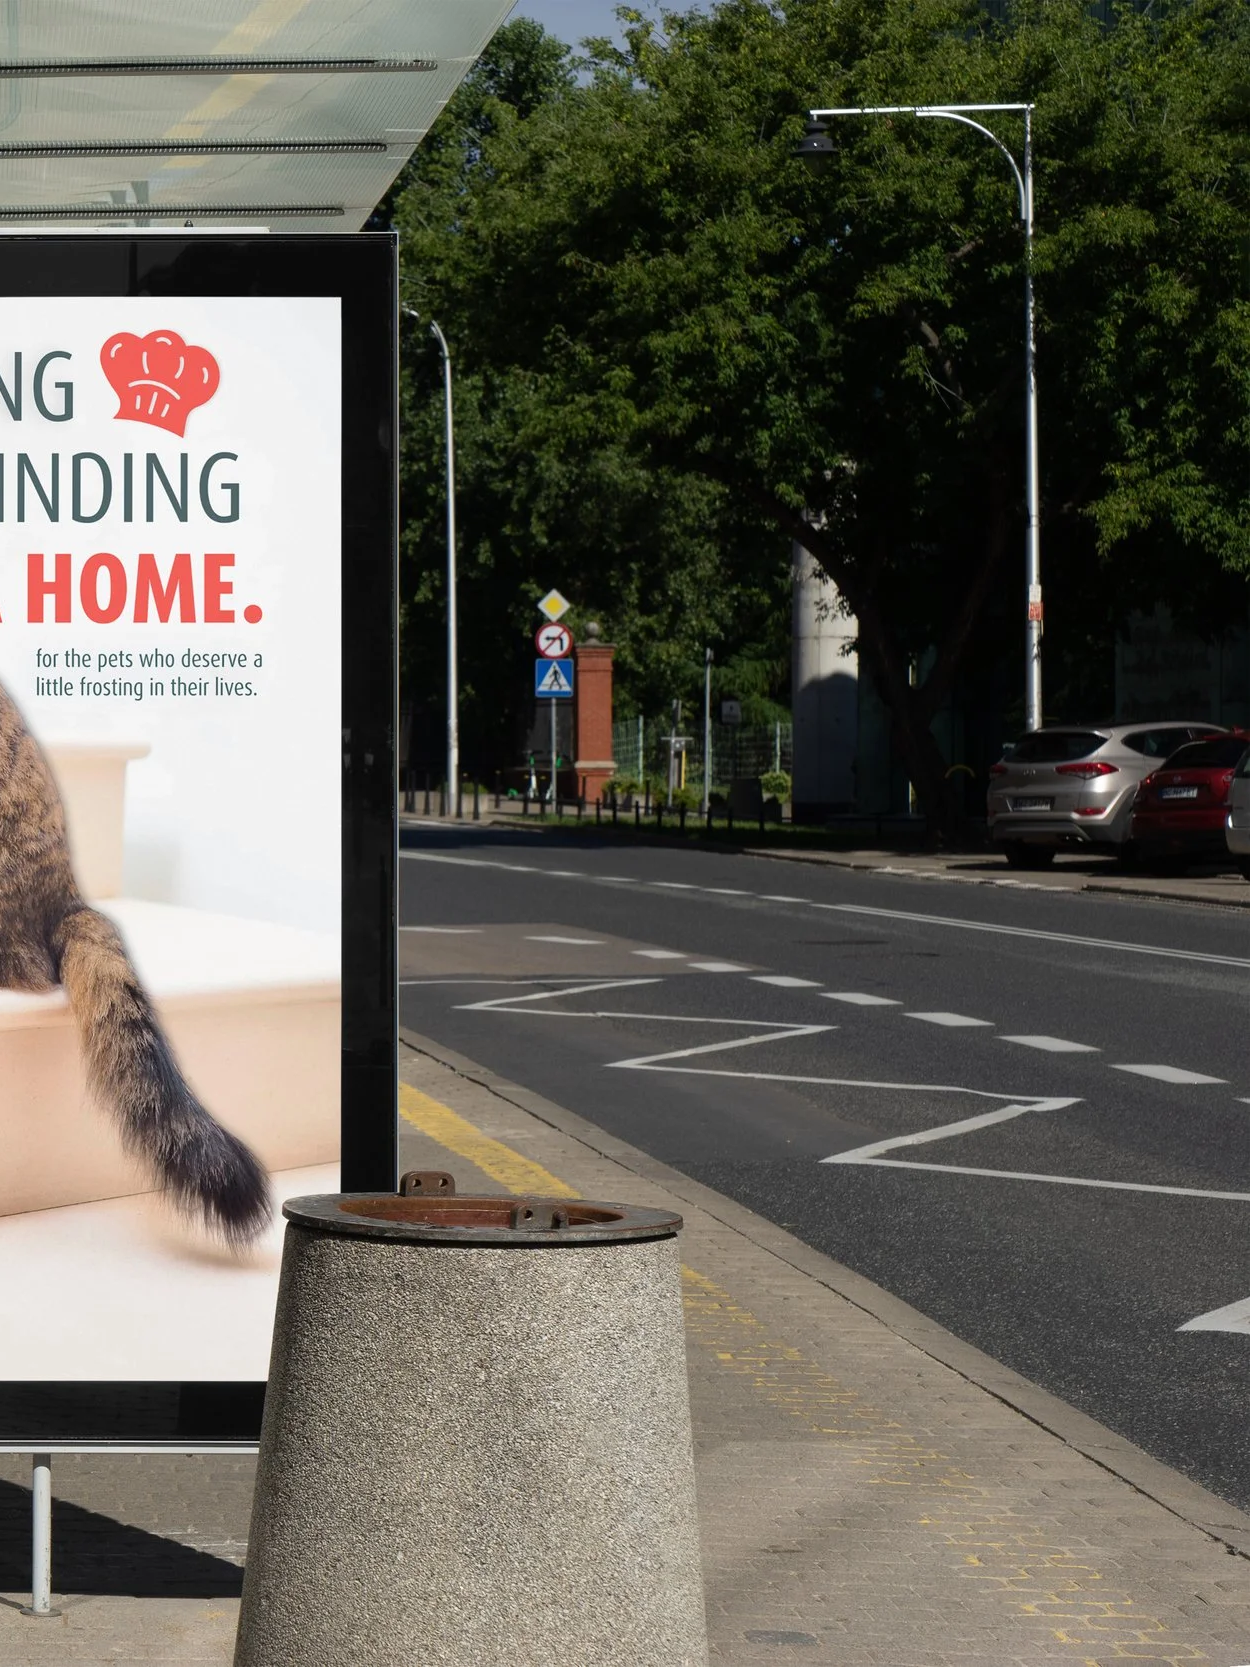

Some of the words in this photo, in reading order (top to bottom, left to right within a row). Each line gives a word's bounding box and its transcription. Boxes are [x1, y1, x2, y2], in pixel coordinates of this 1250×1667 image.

[27, 552, 263, 624] HOME.
[35, 647, 60, 668] for
[64, 647, 92, 668] the
[97, 650, 134, 673] pets
[138, 647, 175, 668] who
[181, 647, 248, 668] deserve
[253, 653, 263, 668] a
[36, 676, 74, 697] little
[79, 676, 143, 702] frosting
[149, 677, 164, 697] in
[170, 676, 210, 697] their
[215, 676, 258, 697] lives.
